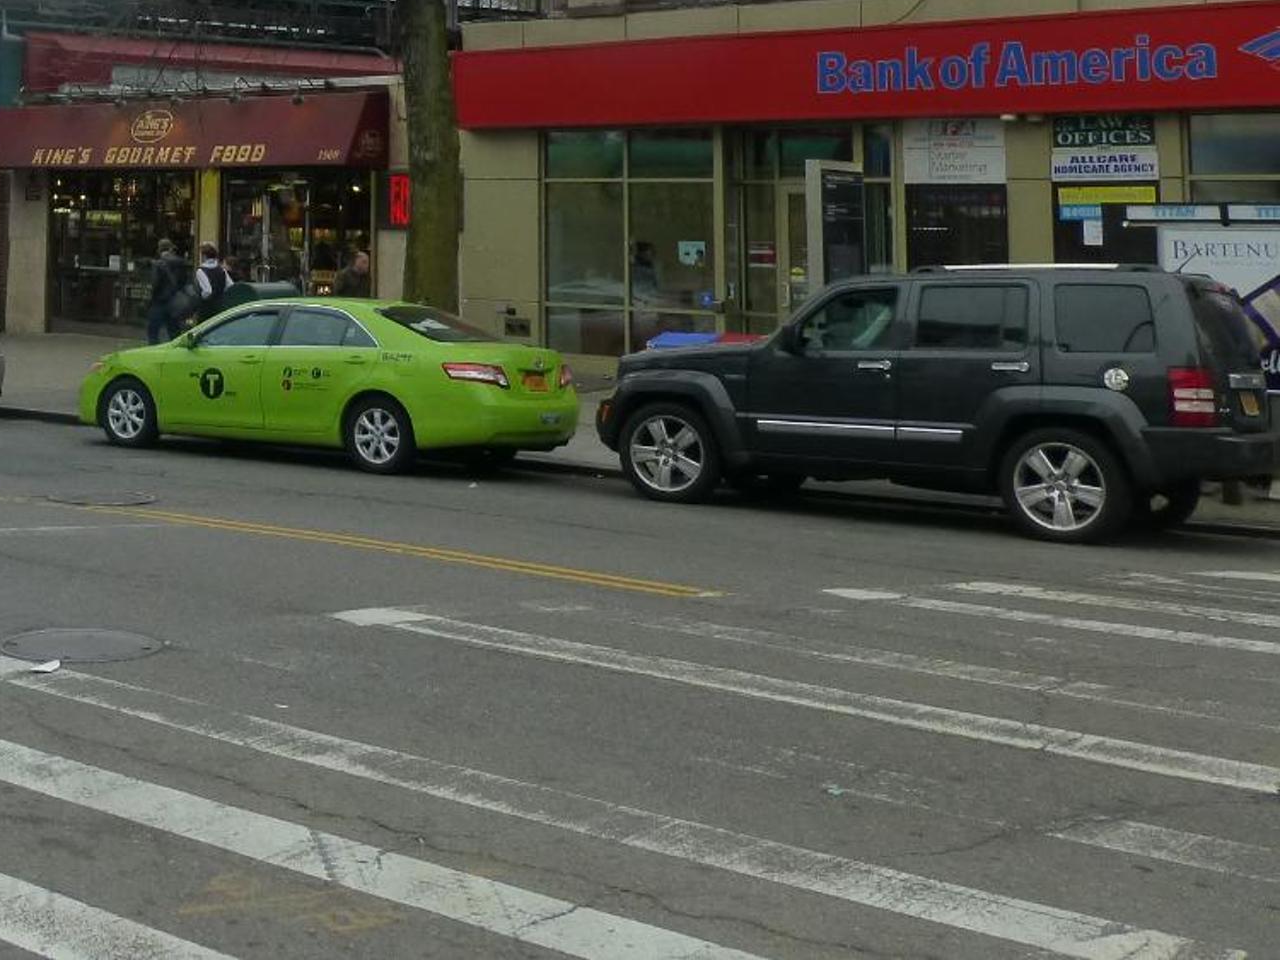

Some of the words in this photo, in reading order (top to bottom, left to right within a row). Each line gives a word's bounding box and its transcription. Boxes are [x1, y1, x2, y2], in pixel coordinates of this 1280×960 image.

[817, 47, 934, 93] Bank
[939, 42, 989, 90] of
[995, 35, 1217, 87] America
[1057, 130, 1151, 145] OFFICES
[31, 146, 92, 165] KING'S
[104, 146, 197, 164] GOURMET
[209, 144, 266, 163] FOOD
[1054, 165, 1111, 174] HOMECARE
[1114, 163, 1155, 173] AGENCY
